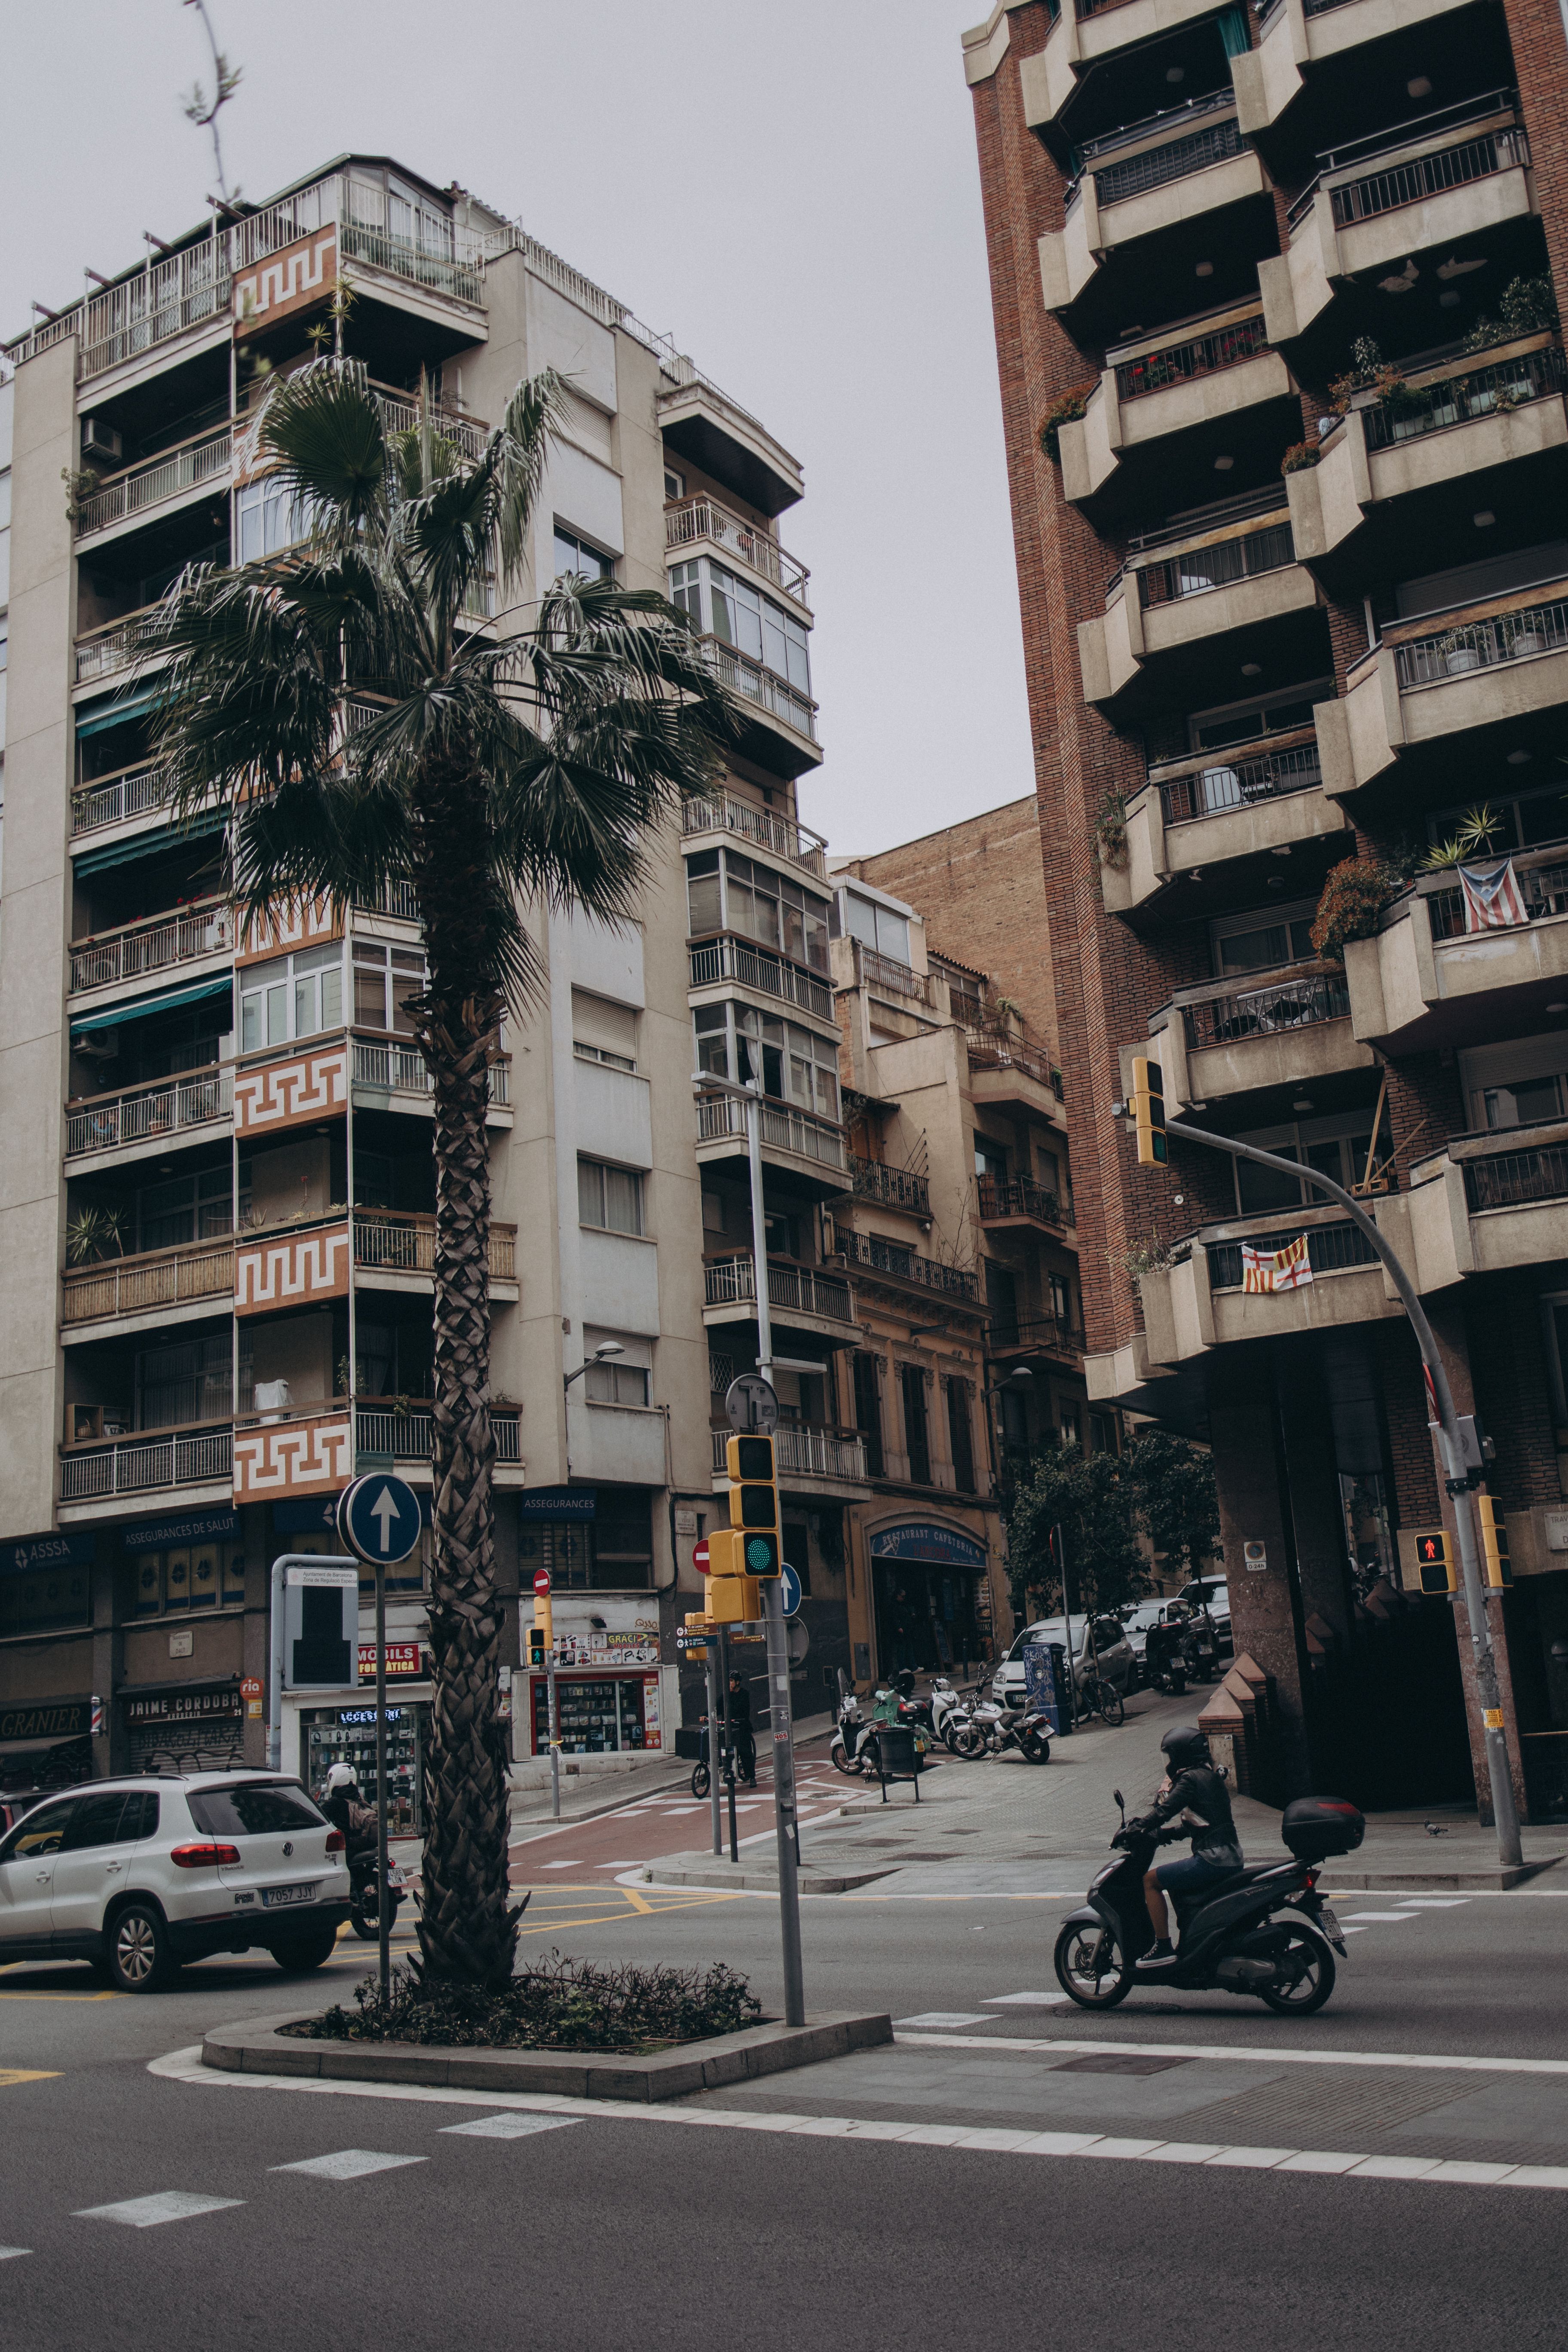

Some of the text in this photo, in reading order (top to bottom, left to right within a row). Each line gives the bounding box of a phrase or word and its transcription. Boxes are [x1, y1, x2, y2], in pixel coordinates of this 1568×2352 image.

[524, 1499, 594, 1508] ASSEGURANCES
[126, 1517, 234, 1545] ASSEGURANCES DE SALUT
[30, 1540, 71, 1560] ASSSA
[882, 1529, 973, 1556] RESTAURANT CAFETERIA
[242, 1679, 260, 1692] ria
[130, 1693, 239, 1716] JAIME CORDOBA
[1, 1707, 81, 1736] GRANIER
[270, 1886, 313, 1903] 7057 JJY
[1320, 1912, 1336, 1925] 9953
[1326, 1925, 1339, 1936] HTL
